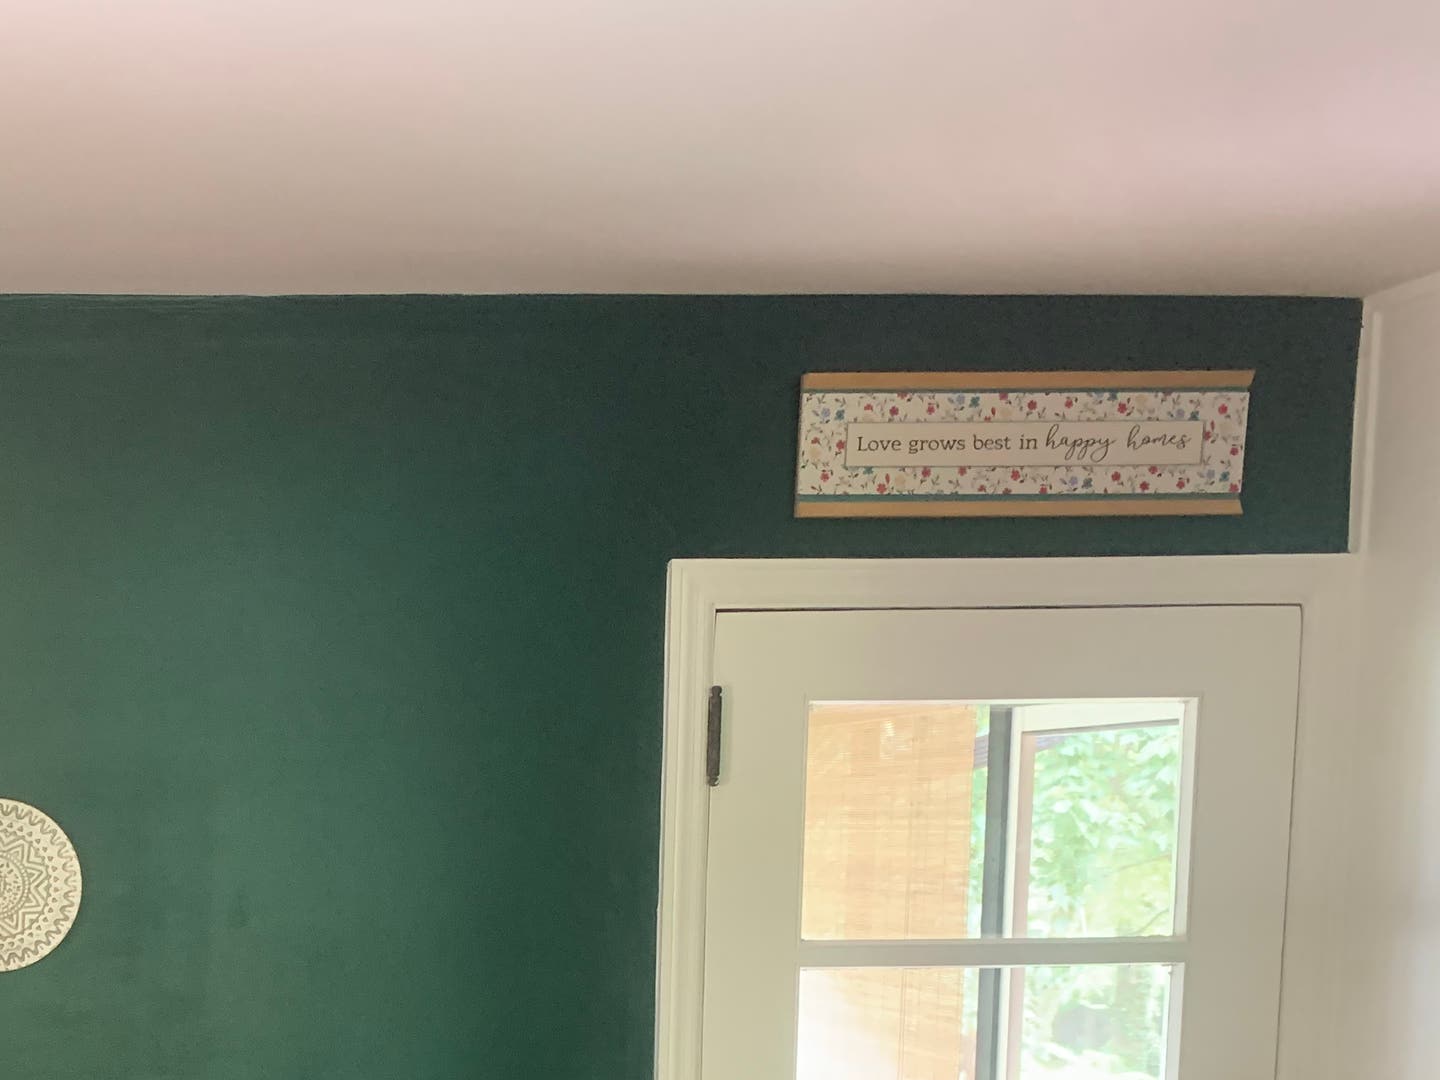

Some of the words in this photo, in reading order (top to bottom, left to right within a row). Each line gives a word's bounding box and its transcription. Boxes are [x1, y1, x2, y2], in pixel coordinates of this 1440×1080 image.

[856, 436, 901, 451] Love
[908, 438, 966, 454] grows
[972, 434, 1011, 450] best
[1019, 434, 1037, 450] in
[1045, 424, 1115, 463] happy
[1126, 424, 1192, 450] homes
